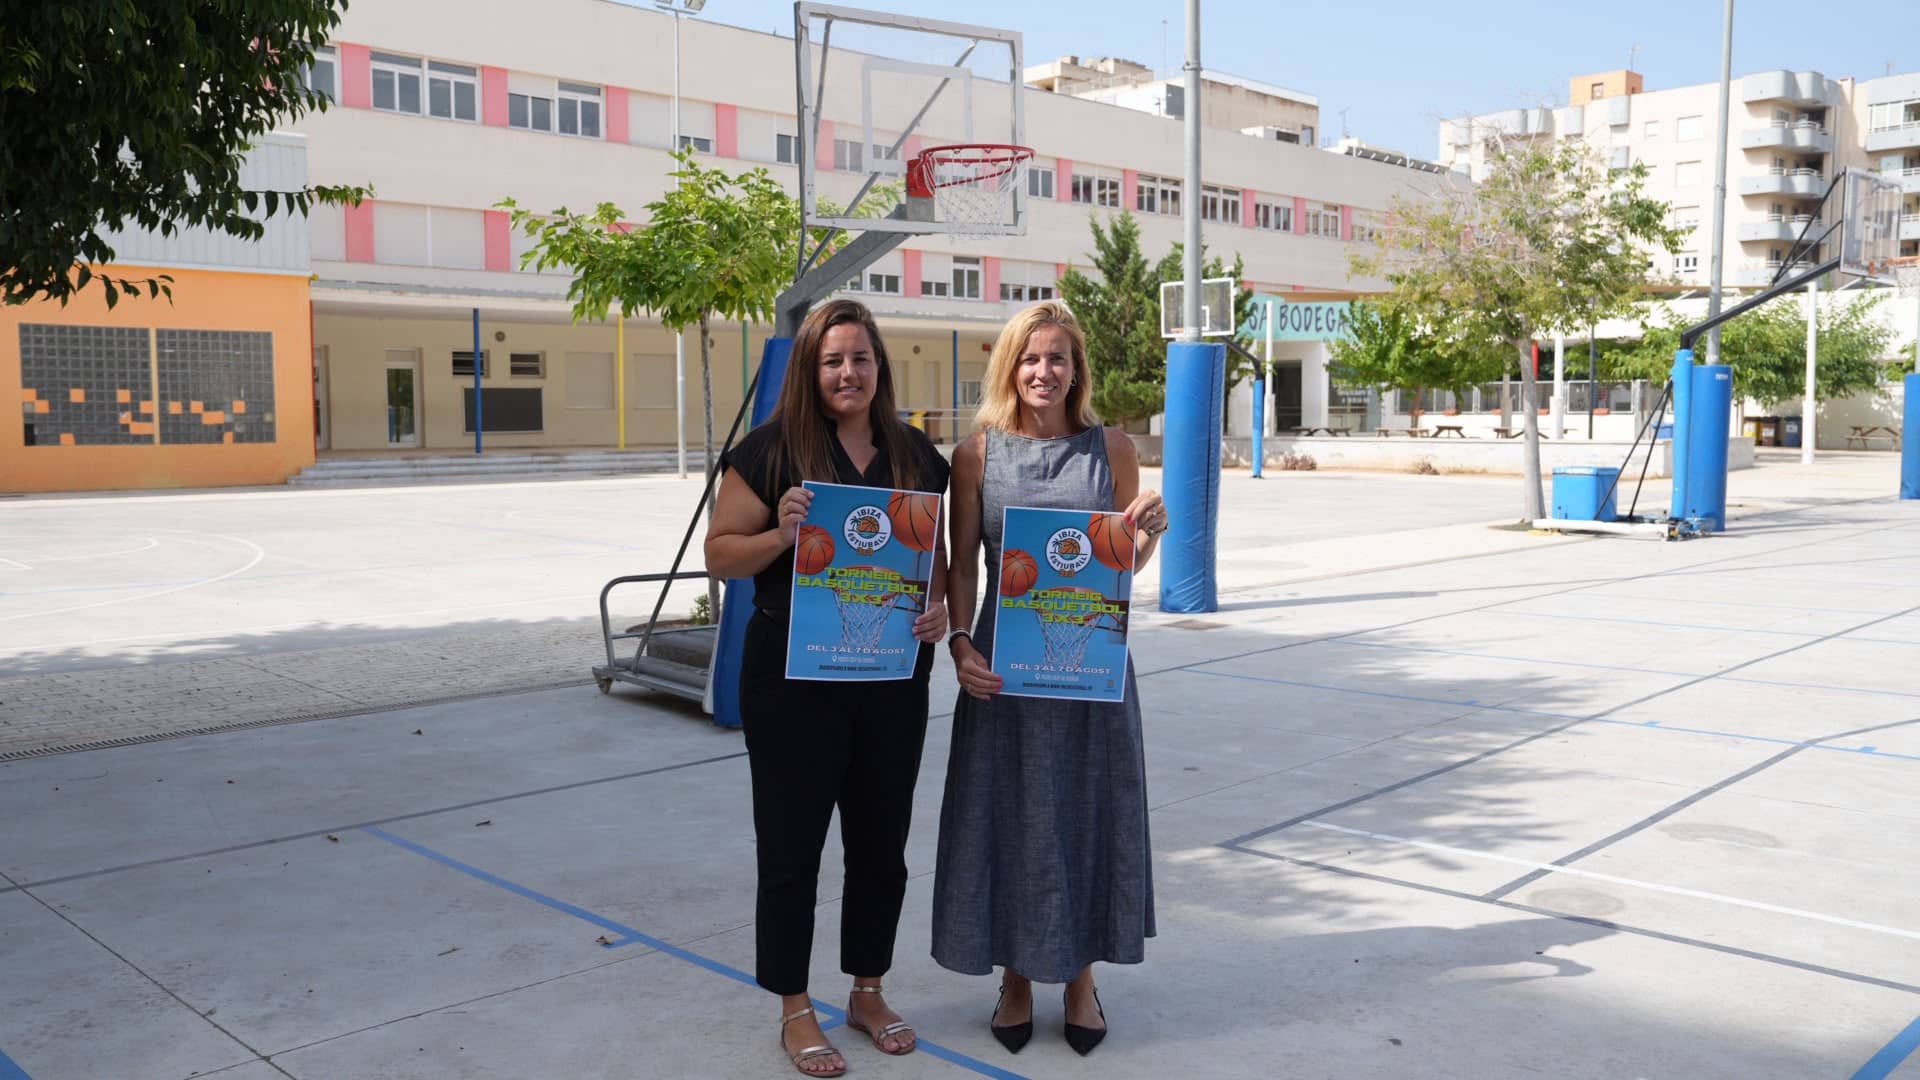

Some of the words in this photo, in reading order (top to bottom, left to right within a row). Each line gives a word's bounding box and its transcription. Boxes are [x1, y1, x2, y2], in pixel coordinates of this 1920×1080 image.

[1279, 304, 1345, 332] BODEGA
[857, 508, 881, 519] IBIZA
[848, 533, 886, 547] ESTIUBALL
[1058, 531, 1082, 541] IBIZA
[1050, 555, 1087, 569] ESTIUBALL
[825, 567, 902, 581] TORNEIG
[797, 577, 925, 595] BASQUETBOL
[1028, 589, 1102, 601] TORNEIG
[1002, 599, 1126, 614] BASQUETBOL
